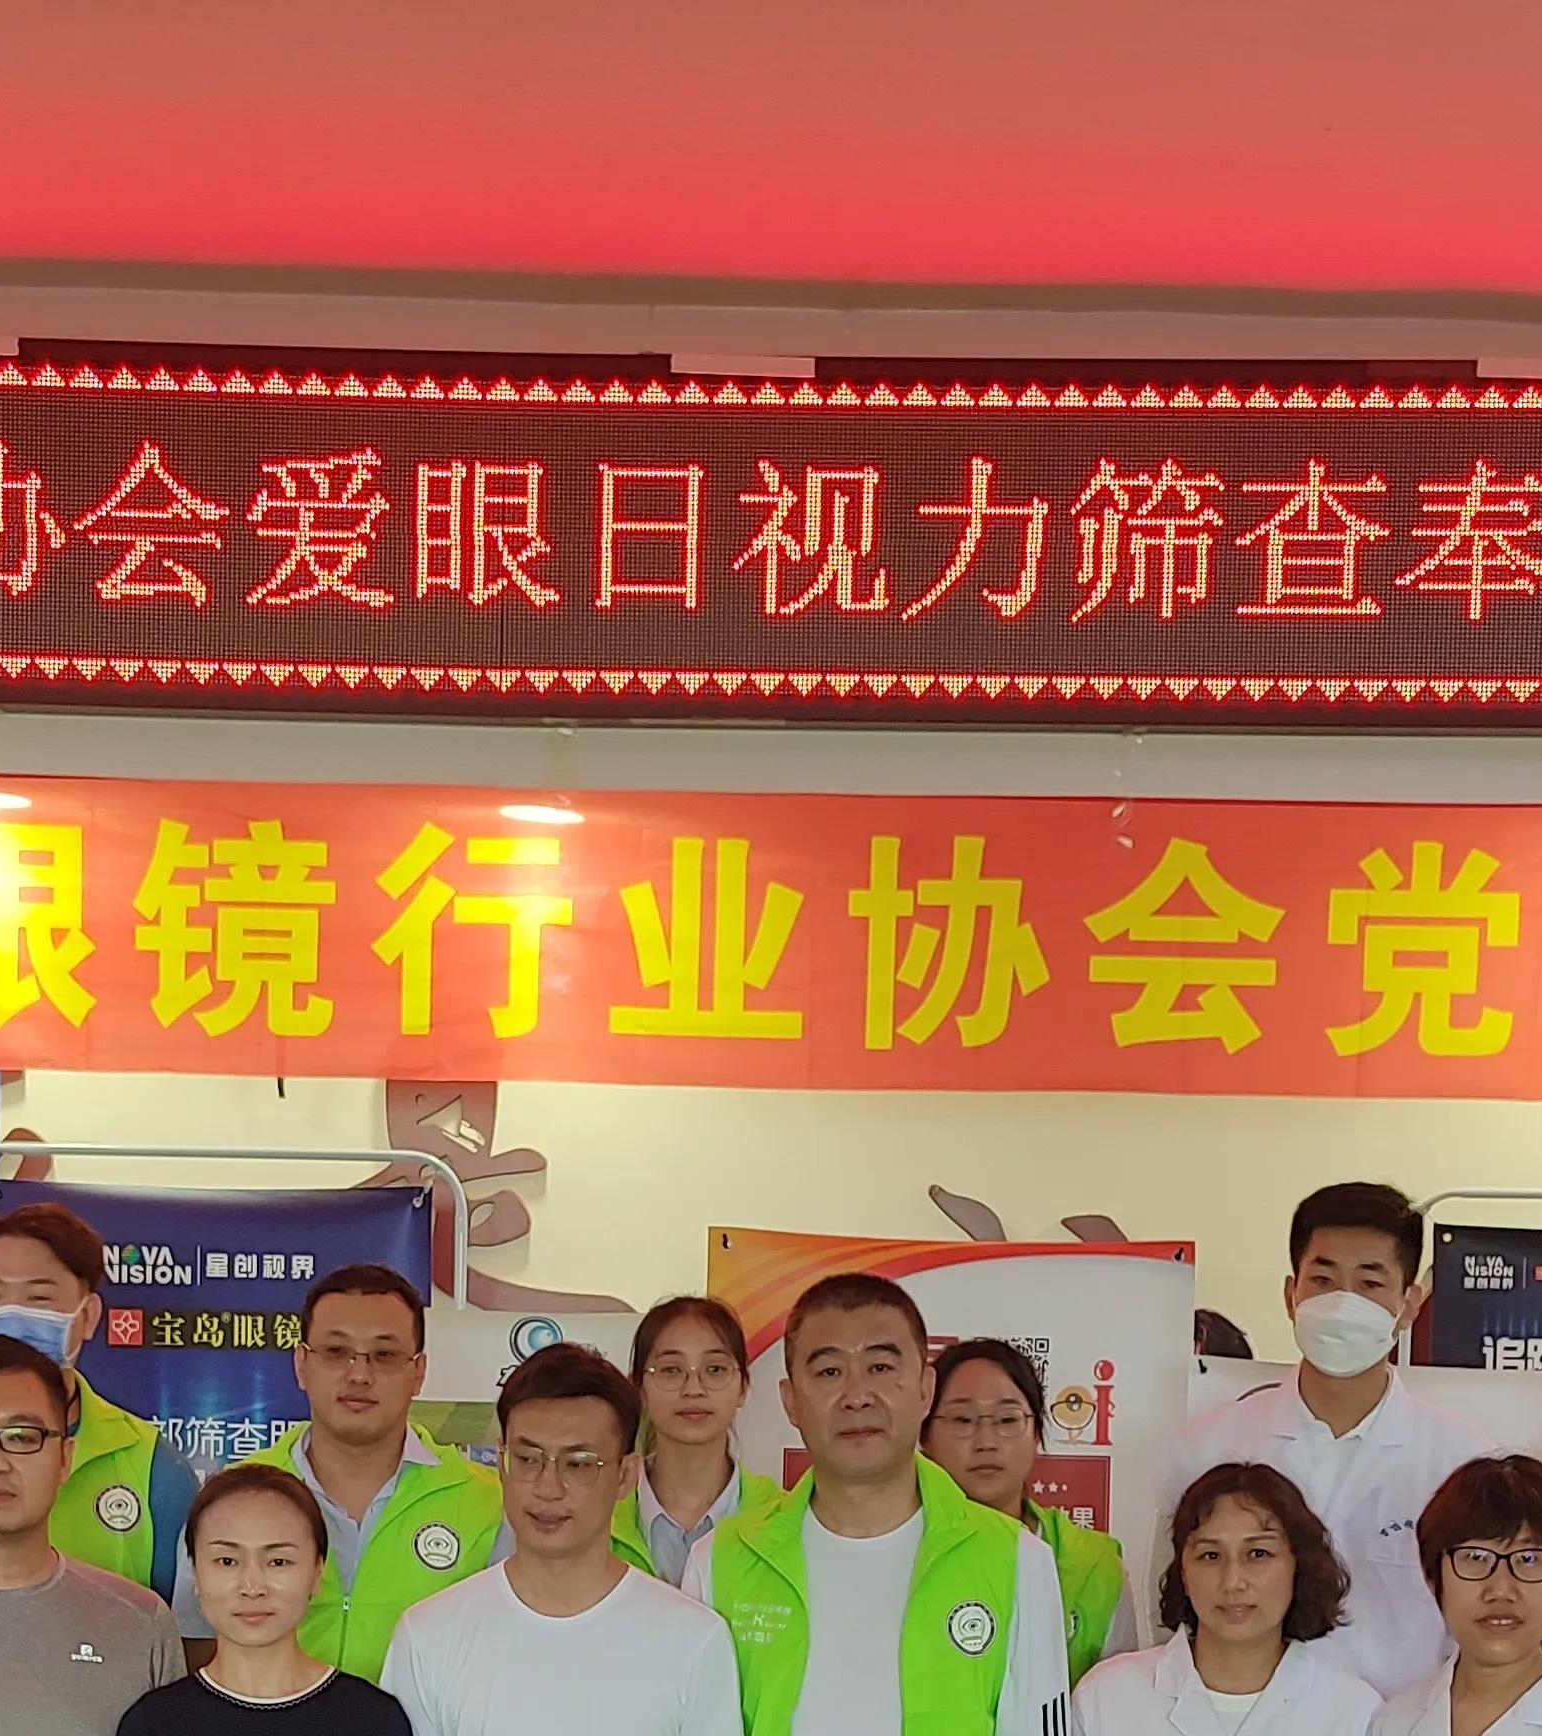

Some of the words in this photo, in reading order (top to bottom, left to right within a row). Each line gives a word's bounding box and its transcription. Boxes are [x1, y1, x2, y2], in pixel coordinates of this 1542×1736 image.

[104, 1264, 193, 1287] VISION
[205, 1252, 316, 1280] 星创视界
